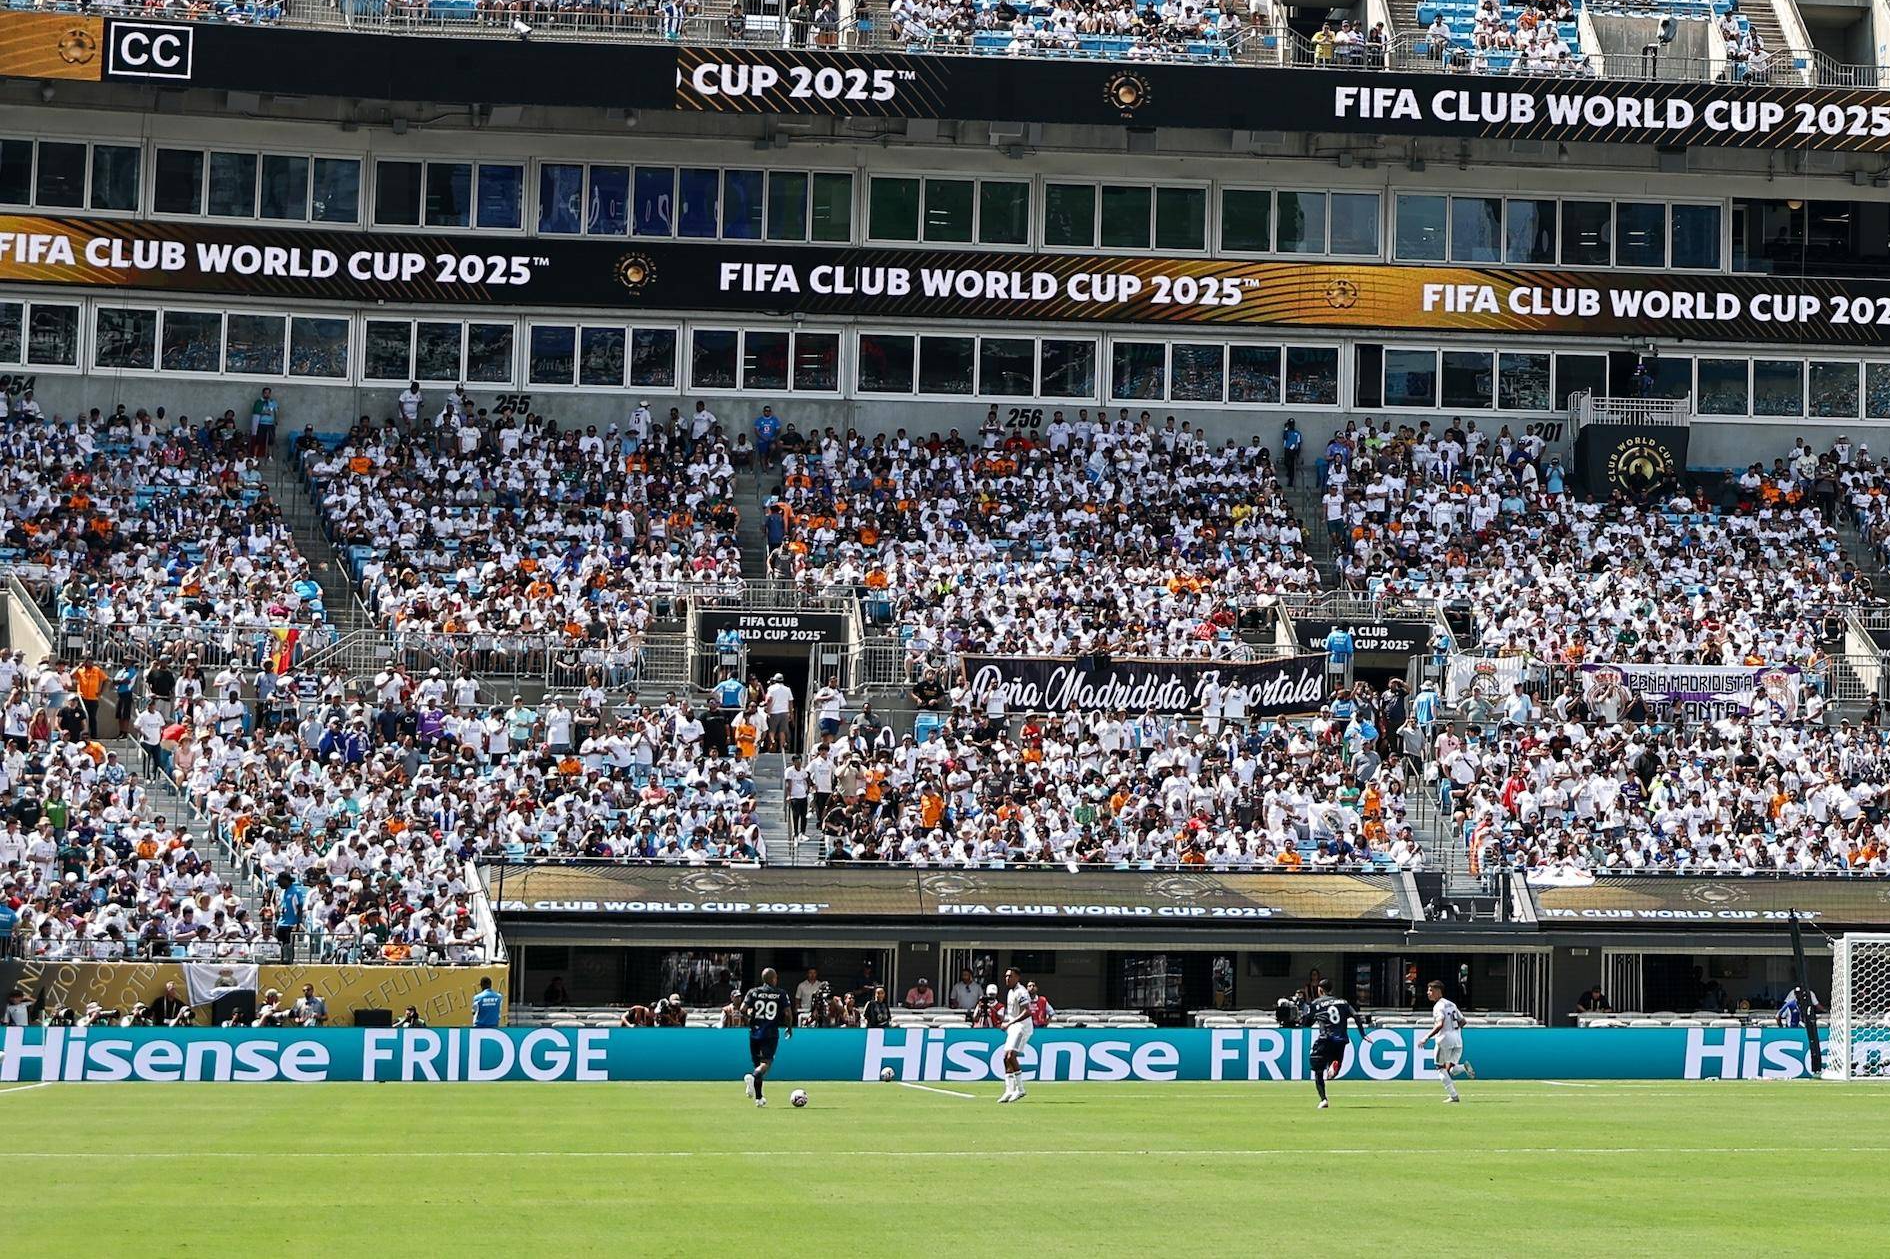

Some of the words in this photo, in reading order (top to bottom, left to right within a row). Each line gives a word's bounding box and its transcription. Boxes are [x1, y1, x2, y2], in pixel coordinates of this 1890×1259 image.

[121, 32, 181, 68] CC
[693, 63, 778, 96] CUP
[1336, 87, 1421, 119] FIFA
[1432, 90, 1535, 123] CLUB
[1546, 95, 1693, 128] WORLD
[1705, 100, 1784, 132] CUP
[0, 233, 75, 264] FIFA
[86, 238, 185, 269] CLUB
[197, 244, 338, 277] WORLD
[348, 252, 425, 280] CUP
[1424, 284, 1500, 313] FIFA
[1509, 287, 1600, 315] CLUB
[1610, 290, 1740, 320] WORLD
[1750, 294, 1820, 322] CUP
[496, 394, 531, 414] 255
[1006, 408, 1043, 428] 256
[1609, 453, 1618, 483] CLUB
[1617, 436, 1656, 453] WORLD
[740, 616, 766, 627] FIFA
[768, 617, 799, 627] CLUB
[1358, 626, 1388, 637] CLUB
[717, 629, 762, 640] WRLD
[763, 629, 788, 640] CUP
[1355, 638, 1378, 649] CUP
[1045, 666, 1198, 711] Madridista
[1629, 671, 1670, 692] PEÑA
[1671, 673, 1754, 693] MADRIDISTA
[490, 900, 528, 912] IFA
[534, 900, 597, 911] CLUB
[604, 901, 695, 912] WORLD
[701, 902, 750, 912] CUP
[939, 904, 990, 915] FIFA
[996, 905, 1058, 915] CLUB
[1063, 905, 1152, 916] WORLD
[1158, 906, 1205, 917] CUP
[754, 1000, 778, 1021] 29
[1328, 1005, 1340, 1025] 8
[2, 1026, 330, 1081] Hisense
[362, 1027, 610, 1081] FRIDGE
[862, 1027, 1181, 1081] Hisense
